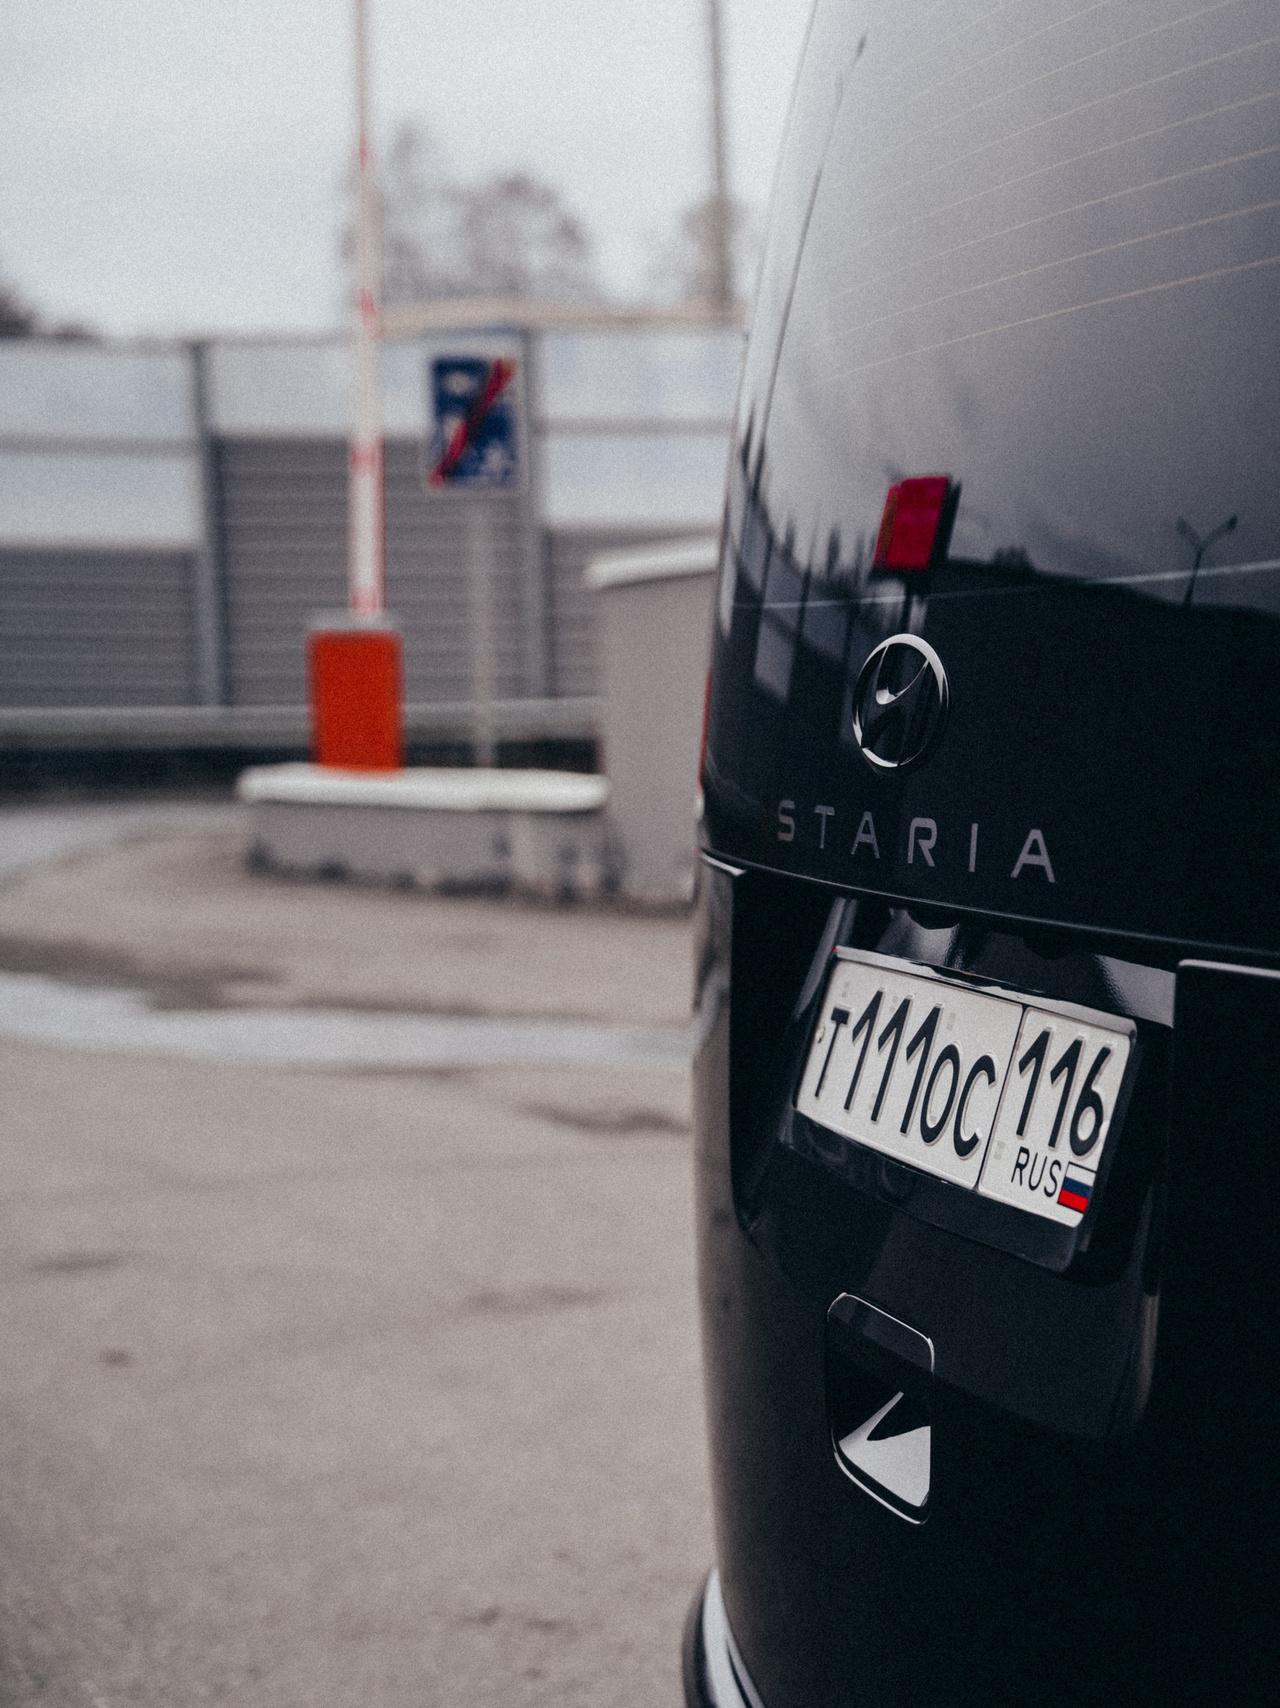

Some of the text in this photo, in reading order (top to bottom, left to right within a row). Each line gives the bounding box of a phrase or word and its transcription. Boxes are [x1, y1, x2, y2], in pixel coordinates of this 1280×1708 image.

[777, 800, 1056, 884] STARIA
[1016, 1028, 1111, 1157] 116
[1010, 1146, 1062, 1198] RUS
